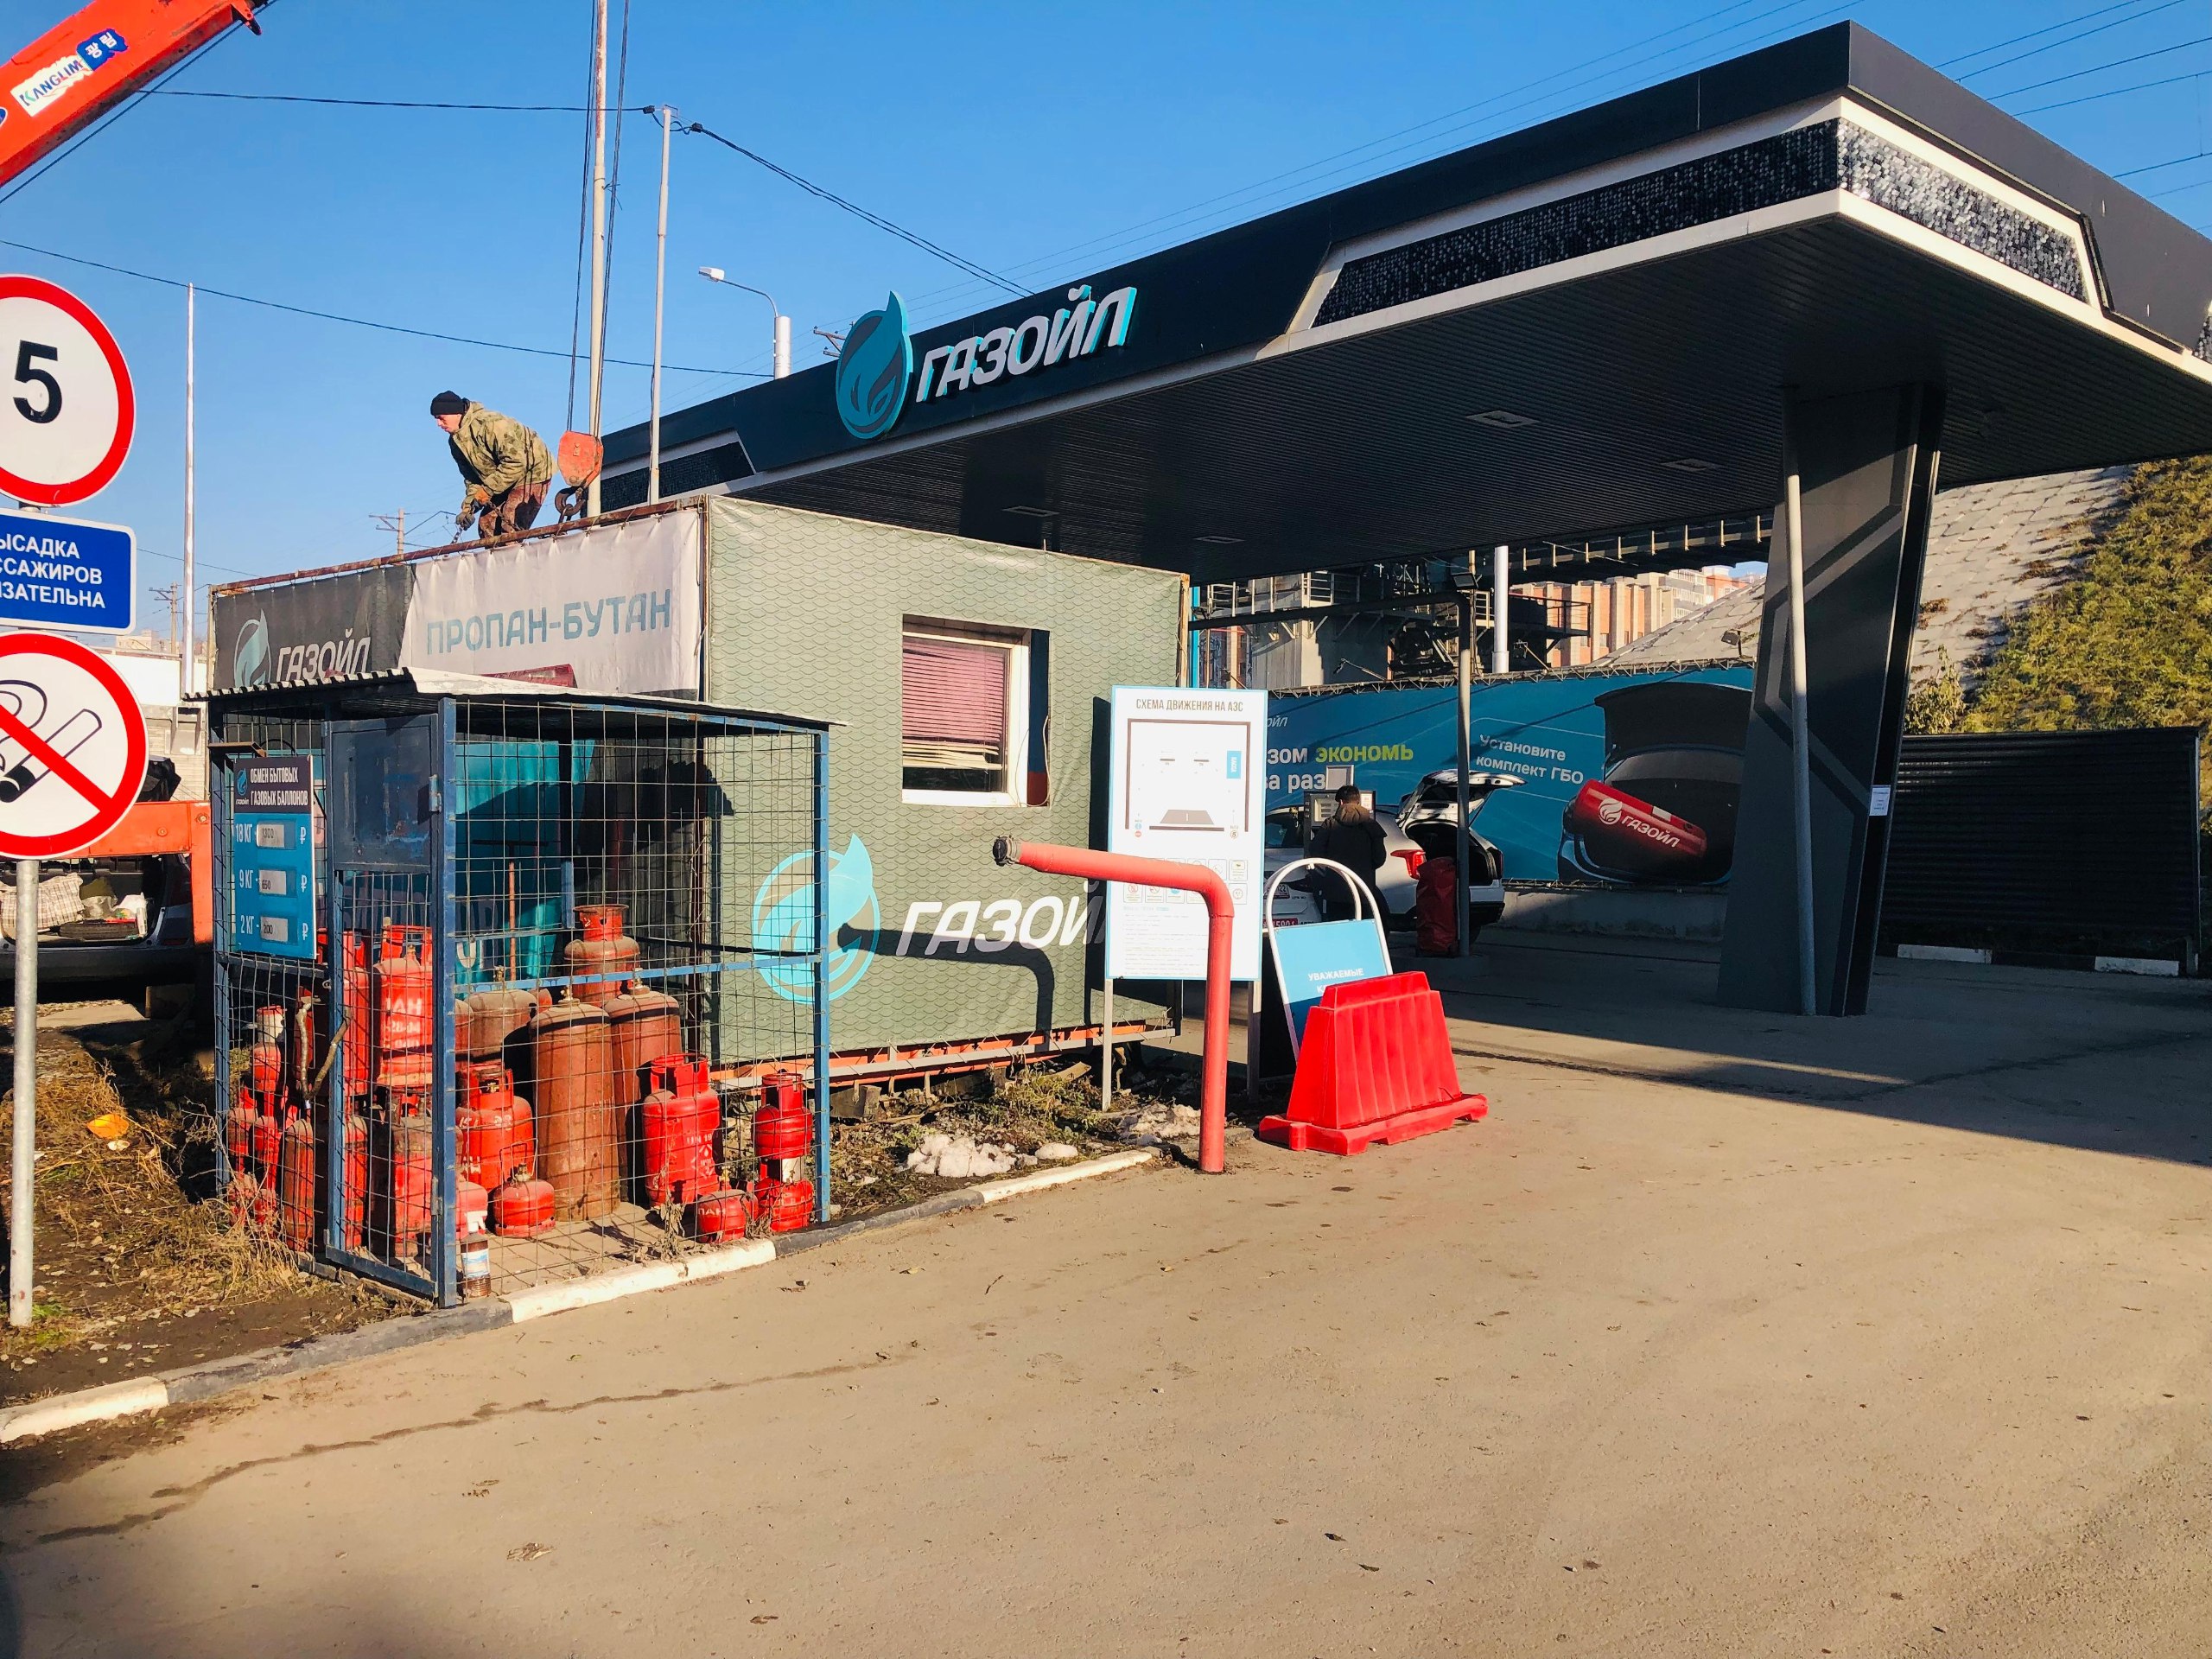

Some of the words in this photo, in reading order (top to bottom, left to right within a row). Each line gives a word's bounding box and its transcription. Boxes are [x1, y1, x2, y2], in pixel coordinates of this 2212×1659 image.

[19, 59, 84, 106] KANGLIM
[916, 284, 1137, 403] ГАЗОЙЛ
[13, 340, 63, 423] 5
[0, 556, 103, 585] САЖИРОВ
[0, 581, 105, 608] ЗАТЕЛЬНА
[426, 589, 671, 655] ПРОПАН-БУТАН
[276, 628, 371, 683] ГАЗОЙЛ
[1136, 698, 1164, 709] СХЕМА
[1166, 699, 1212, 711] ДВИЖЕНИЯ
[1214, 701, 1225, 711] НА
[1228, 702, 1243, 712] АЗС
[1479, 734, 1566, 761] Установите
[250, 767, 269, 784] ОБМЕН
[270, 767, 298, 784] БЫТОВЫХ
[1476, 755, 1547, 778] комплект
[1550, 766, 1584, 785] ГБО
[251, 790, 276, 806] ГАЗОВЫХ
[276, 790, 308, 806] БАЛЛОНОВ
[235, 823, 244, 842] 18
[244, 823, 252, 843] КГ
[300, 827, 307, 845] ₽
[1621, 815, 1680, 848] ГАЗОЙЛ
[239, 869, 244, 888] 9
[245, 869, 254, 889] КГ
[262, 879, 271, 890] 650
[301, 874, 308, 893] ₽
[240, 914, 245, 934] 2
[246, 914, 255, 935] КГ
[263, 924, 273, 934] 200
[302, 923, 308, 941] ₽
[896, 880, 1105, 956] ГАЗОЙ
[1307, 968, 1364, 982] УВАЖАЕМЫЕ
